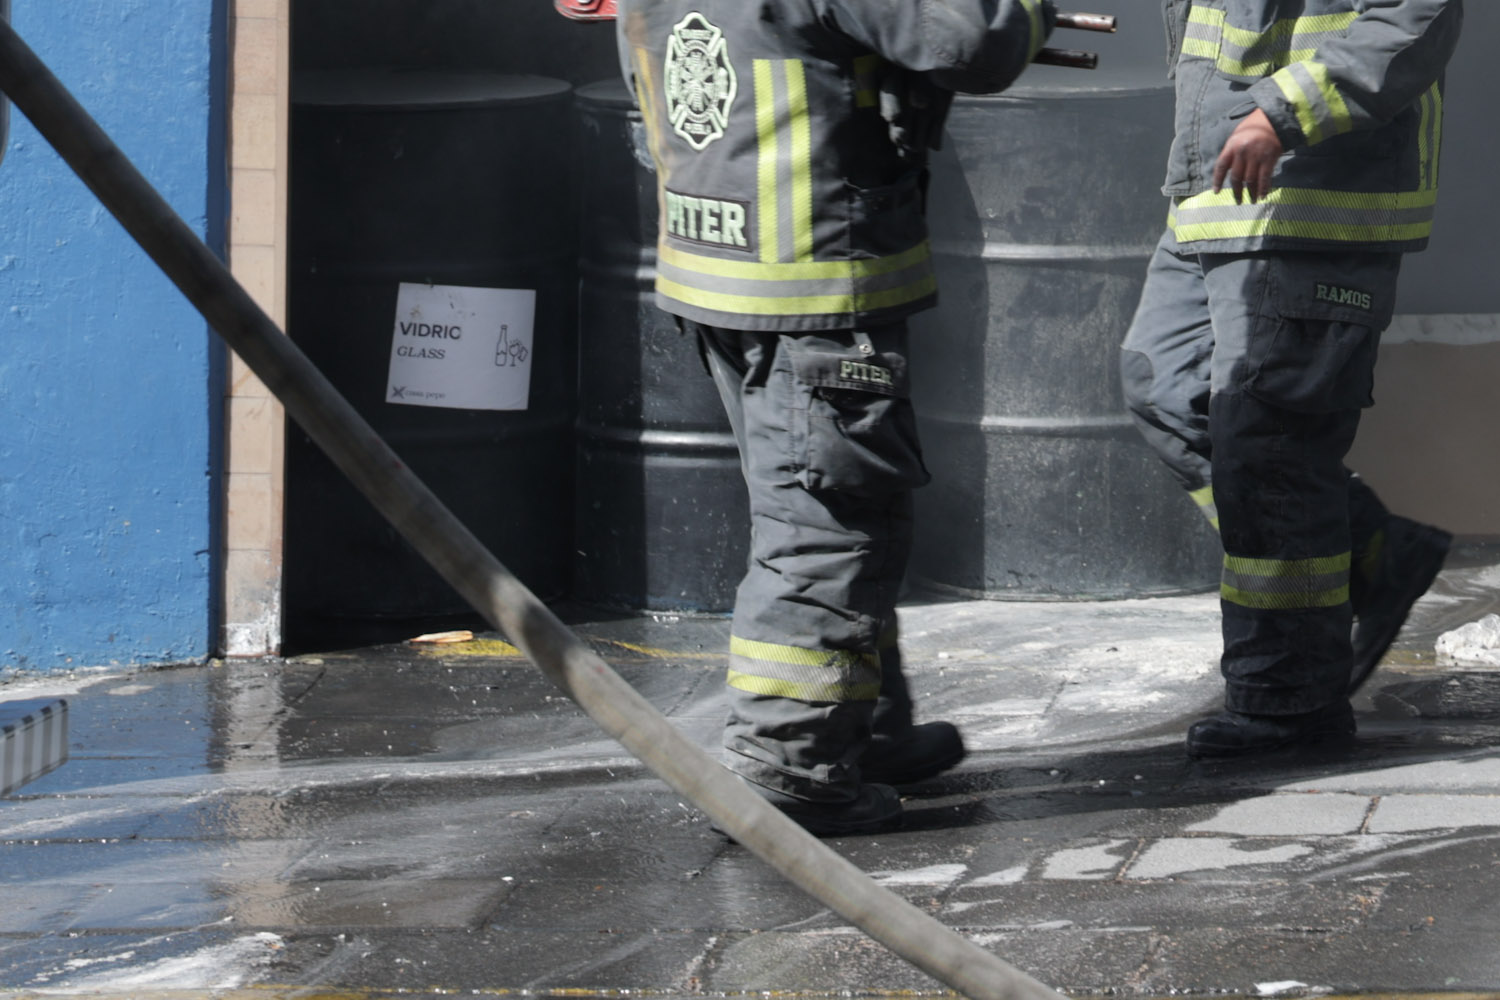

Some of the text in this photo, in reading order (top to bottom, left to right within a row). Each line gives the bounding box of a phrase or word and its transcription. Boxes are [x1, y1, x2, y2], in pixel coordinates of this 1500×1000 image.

[1316, 284, 1371, 309] RAMOS
[397, 345, 446, 359] GLASS
[840, 360, 894, 385] PITER
